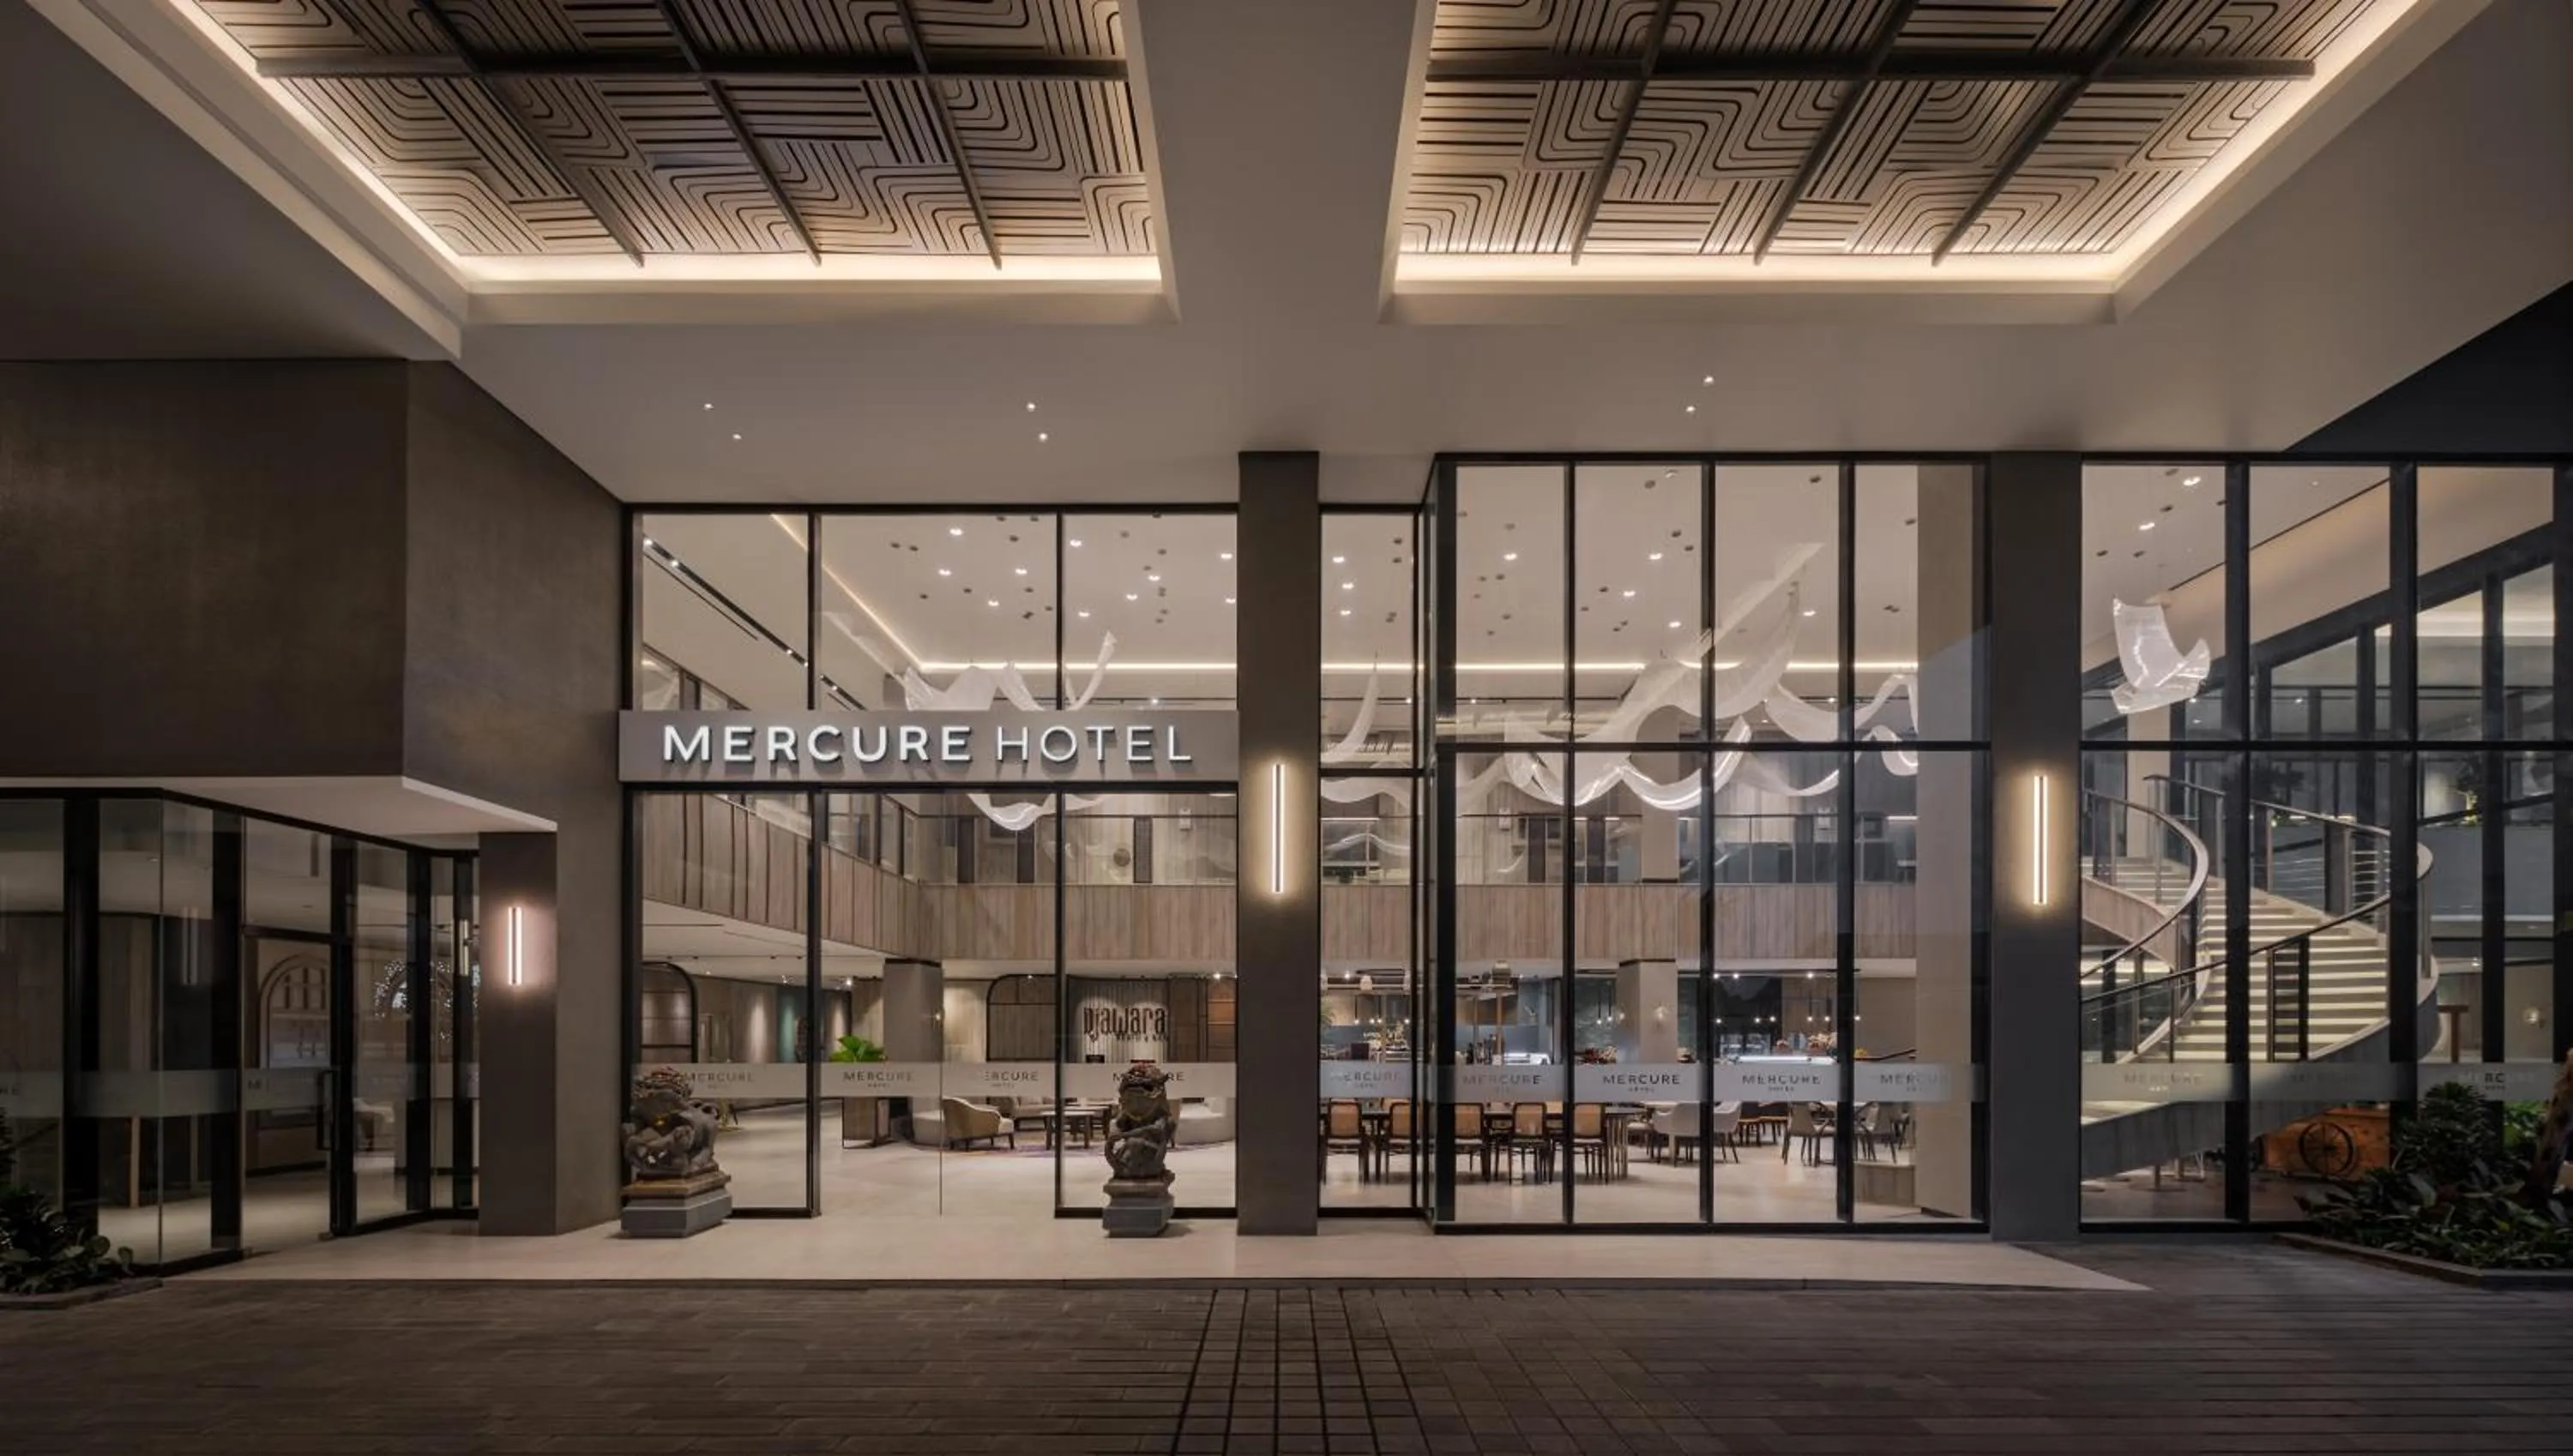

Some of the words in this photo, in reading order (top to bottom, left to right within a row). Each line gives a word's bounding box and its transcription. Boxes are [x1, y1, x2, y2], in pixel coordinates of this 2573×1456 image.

[663, 725, 971, 762] MERCURE
[997, 725, 1192, 762] HOTEL
[842, 1071, 914, 1081] MERCURE
[985, 1071, 1038, 1081] ERCURE
[1602, 1074, 1681, 1085] MERCURE
[1742, 1074, 1821, 1085] MERCURE
